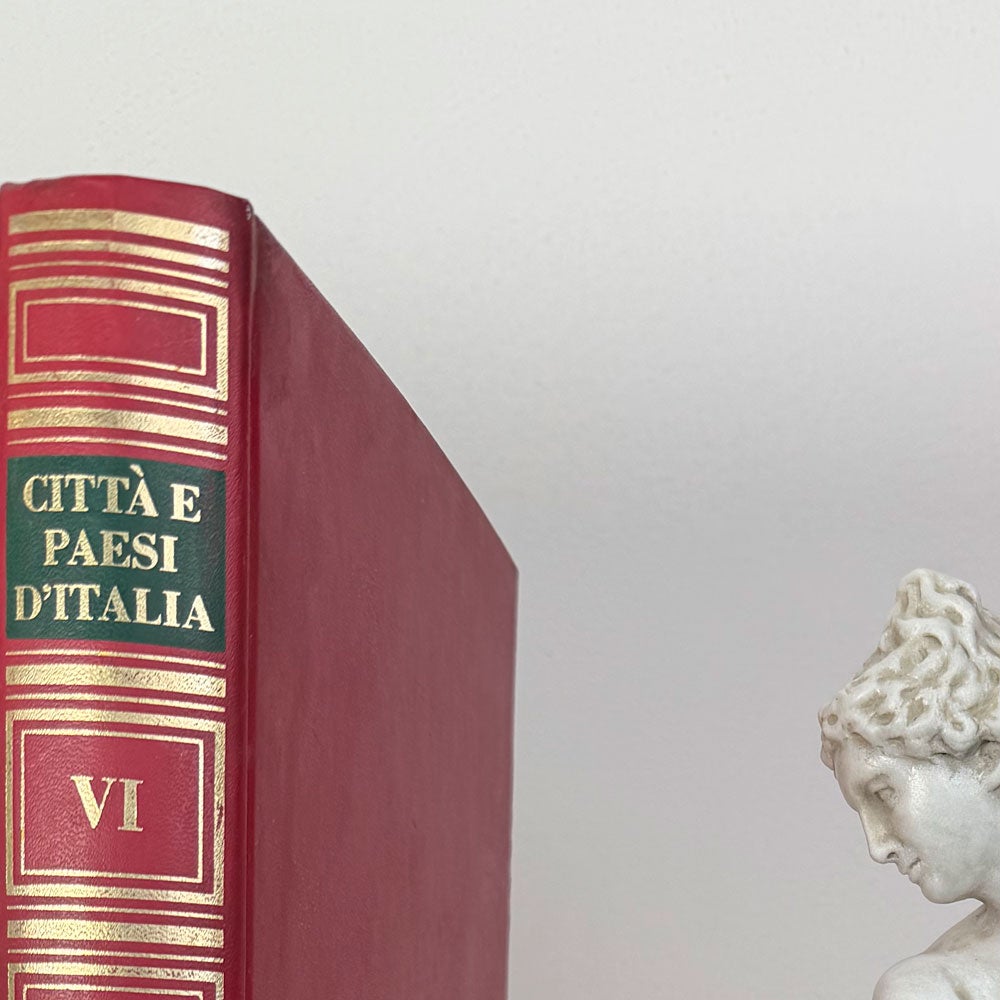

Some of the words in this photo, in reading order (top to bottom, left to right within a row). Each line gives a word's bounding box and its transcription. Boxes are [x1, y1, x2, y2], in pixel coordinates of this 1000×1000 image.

[22, 464, 159, 518] CITTÀ
[169, 483, 202, 523] E
[43, 528, 179, 573] PAESI
[14, 583, 215, 632] D'ITALIA
[70, 775, 144, 832] VI
